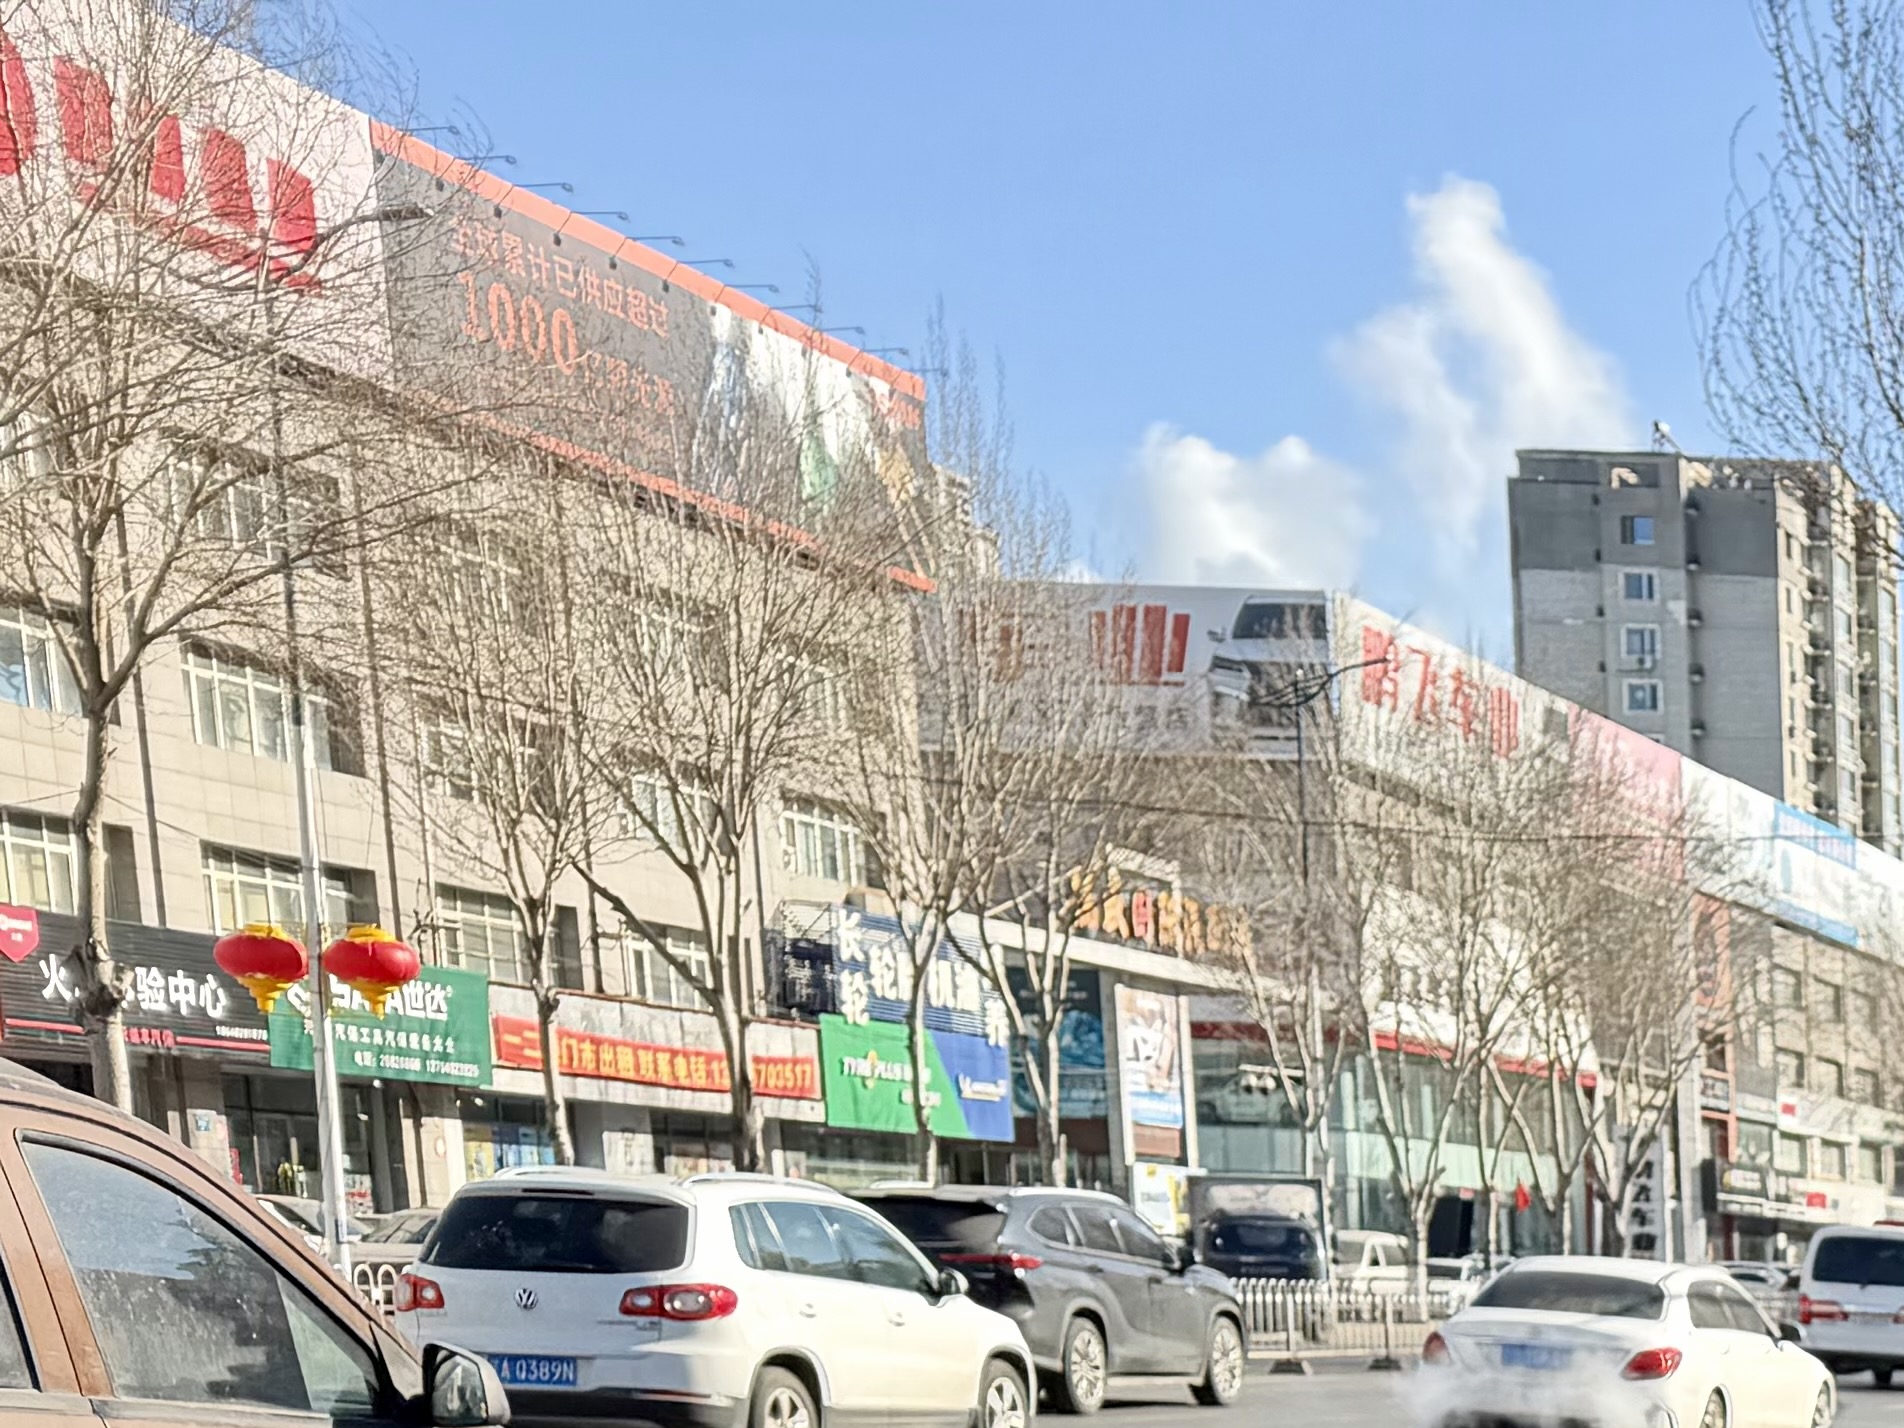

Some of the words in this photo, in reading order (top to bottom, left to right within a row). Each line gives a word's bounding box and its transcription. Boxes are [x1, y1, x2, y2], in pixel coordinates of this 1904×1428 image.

[502, 1030, 634, 1077] 一二门市出租
